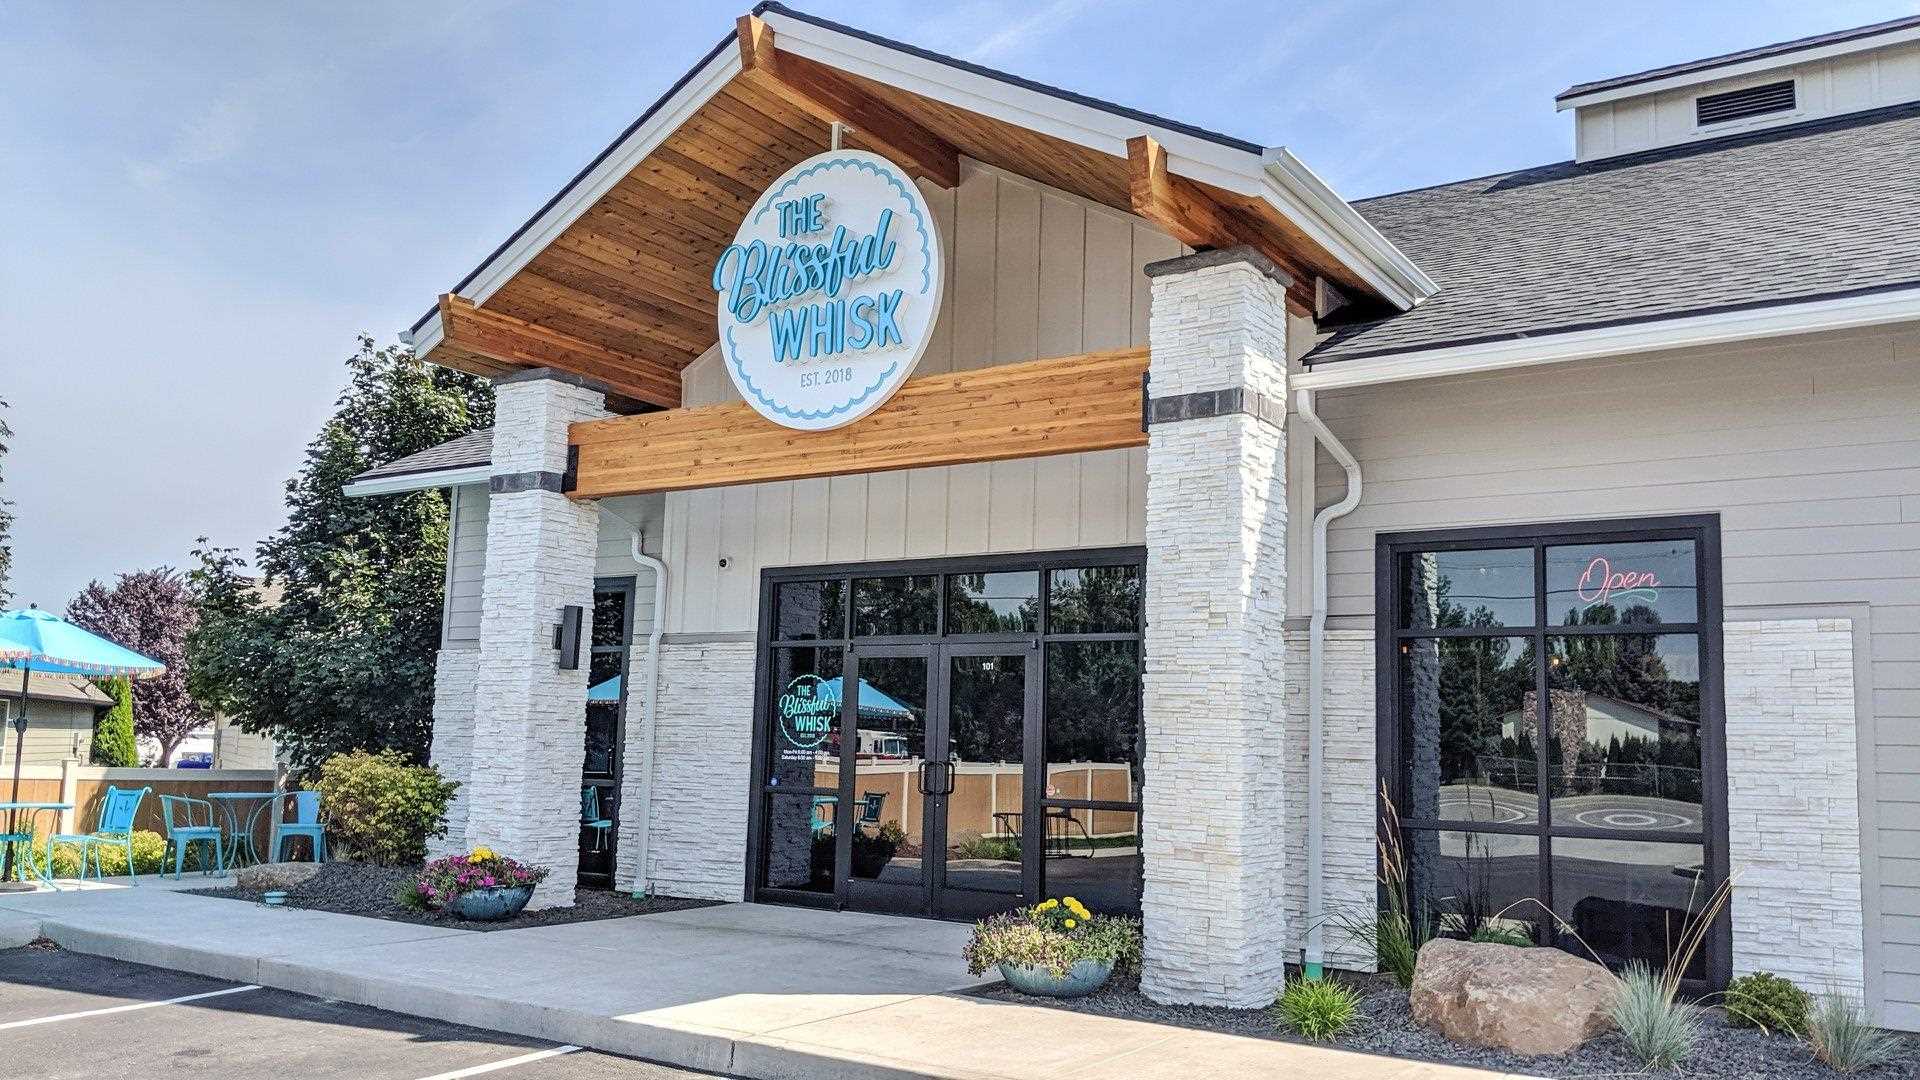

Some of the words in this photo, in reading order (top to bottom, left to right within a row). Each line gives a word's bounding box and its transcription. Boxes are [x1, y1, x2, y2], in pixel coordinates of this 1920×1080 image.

[775, 193, 825, 238] THE
[711, 208, 897, 323] Blissful
[769, 289, 903, 362] WHISK
[800, 371, 821, 388] EST.
[824, 367, 852, 384] 2018
[1579, 557, 1660, 604] Open
[982, 662, 994, 671] 101
[797, 685, 811, 696] THE
[779, 694, 831, 718] Blissful
[795, 716, 831, 732] WHISK
